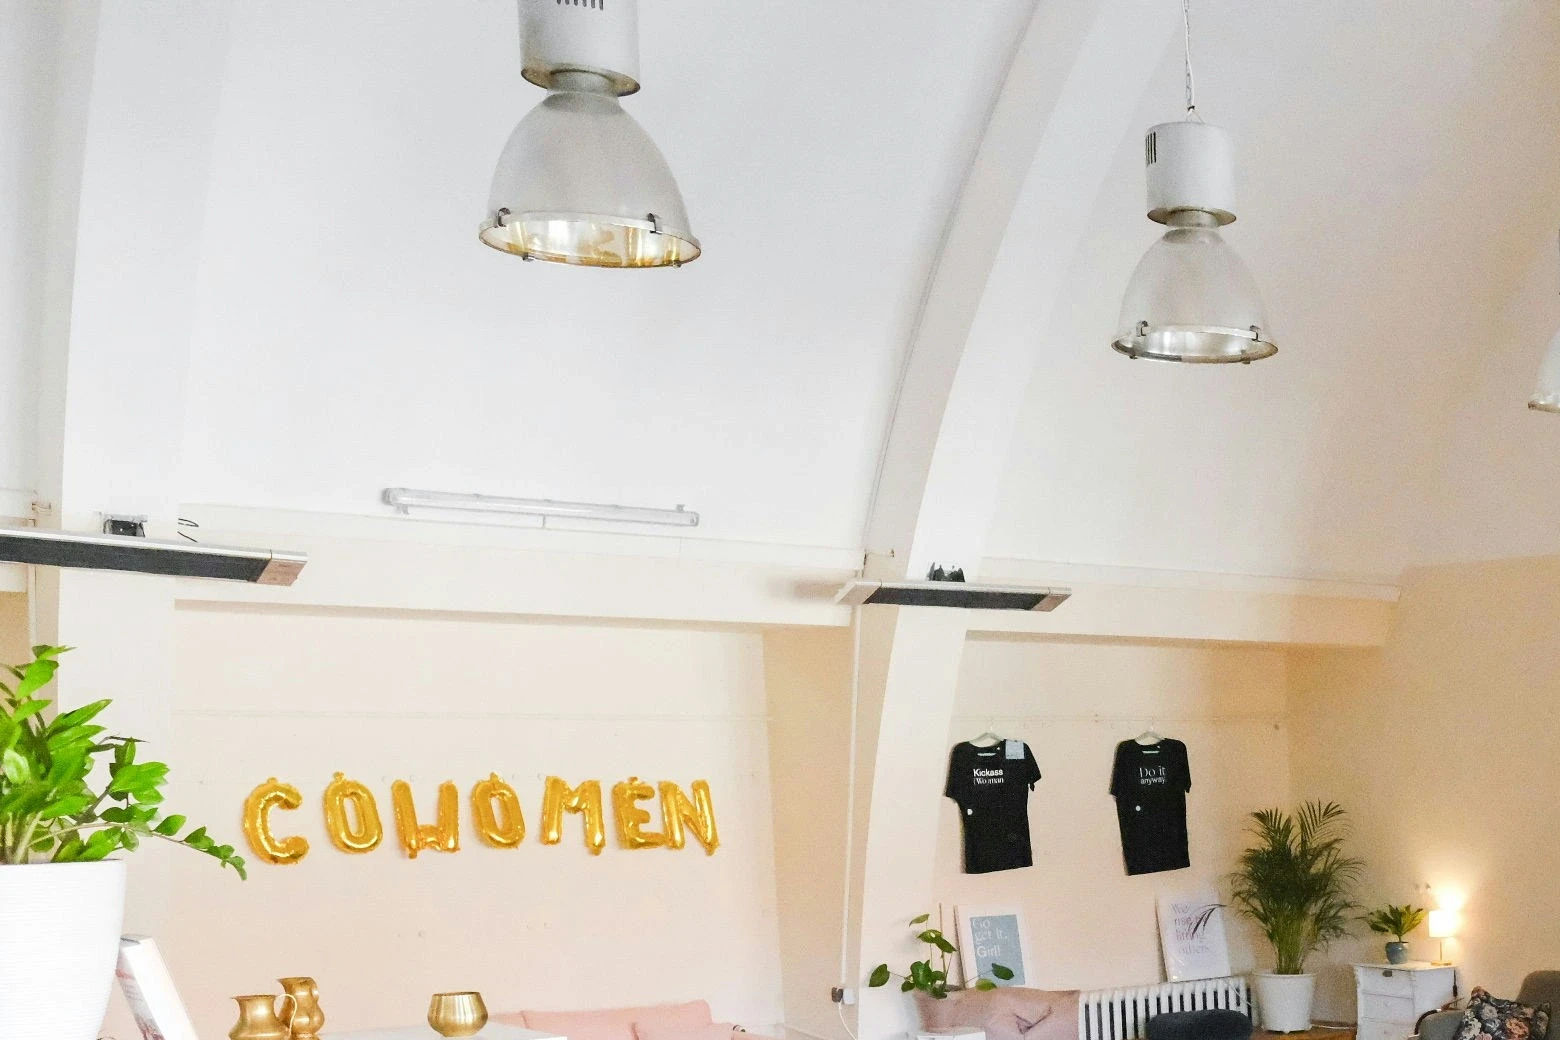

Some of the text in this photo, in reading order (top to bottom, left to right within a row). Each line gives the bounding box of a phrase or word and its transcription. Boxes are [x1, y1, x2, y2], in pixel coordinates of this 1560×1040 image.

[973, 768, 1004, 777] Kickass
[1139, 765, 1166, 778] Do it
[241, 771, 720, 866] COWOMEN
